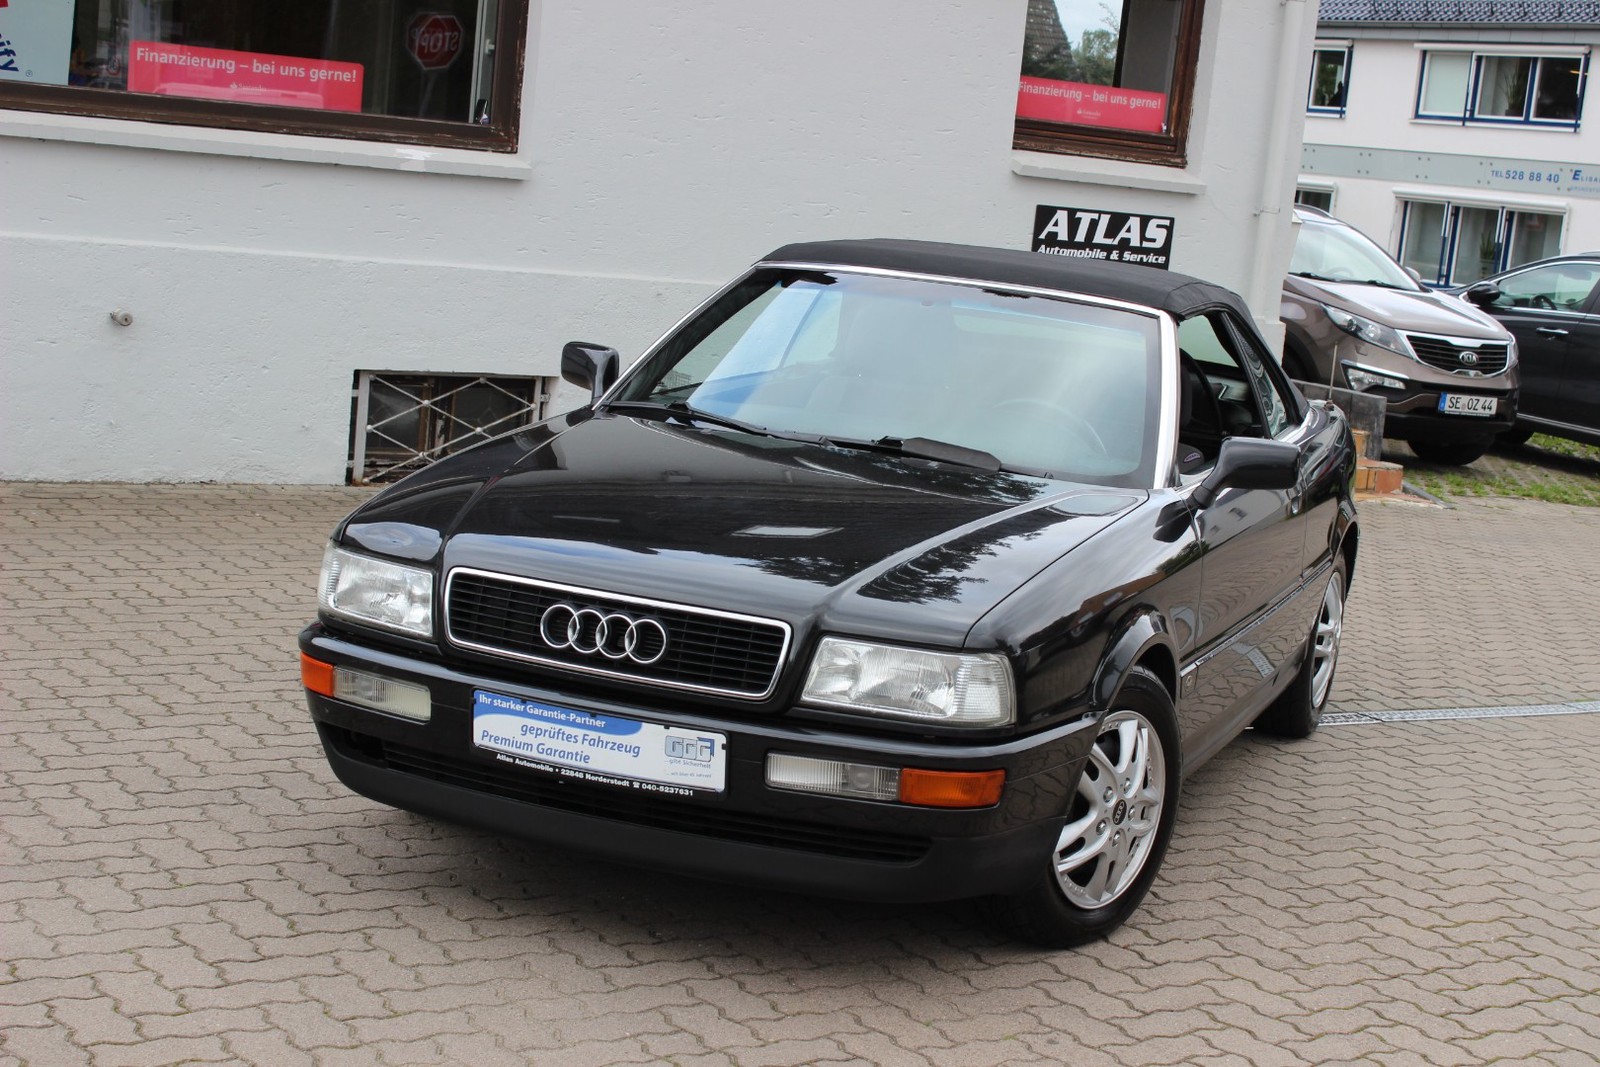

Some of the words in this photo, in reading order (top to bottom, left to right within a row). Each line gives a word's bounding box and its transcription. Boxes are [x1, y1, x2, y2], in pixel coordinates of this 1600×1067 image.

[136, 47, 236, 73] Finanzierung
[252, 59, 276, 74] bei
[280, 65, 305, 78] uns
[309, 68, 357, 82] gerne!
[1018, 81, 1082, 102] Finanzierung
[1092, 90, 1108, 103] bei
[1110, 94, 1127, 104] uns
[1129, 98, 1161, 109] gerne!
[1491, 170, 1504, 178] TEL
[1505, 170, 1524, 180] 528
[1528, 172, 1542, 182] 88
[1546, 174, 1560, 183] 40
[1038, 209, 1170, 249] ATLAS
[1037, 244, 1107, 260] Automobile
[1109, 250, 1120, 260] &
[1122, 250, 1166, 264] Service
[1448, 396, 1461, 409] SE
[1467, 398, 1480, 411] OZ
[1481, 399, 1493, 412] 44
[479, 694, 492, 704] Ihr
[493, 699, 525, 712] starker
[526, 704, 606, 728] Garantie-Partner
[481, 729, 533, 752] Premium
[536, 742, 591, 763] Garantie
[520, 723, 579, 744] geprüftes
[581, 733, 641, 757] Fahrzeug
[496, 753, 514, 763] Atlas
[515, 758, 554, 773] Automobile
[585, 772, 630, 787] Norderstedt
[641, 783, 694, 796] 040-5237631
